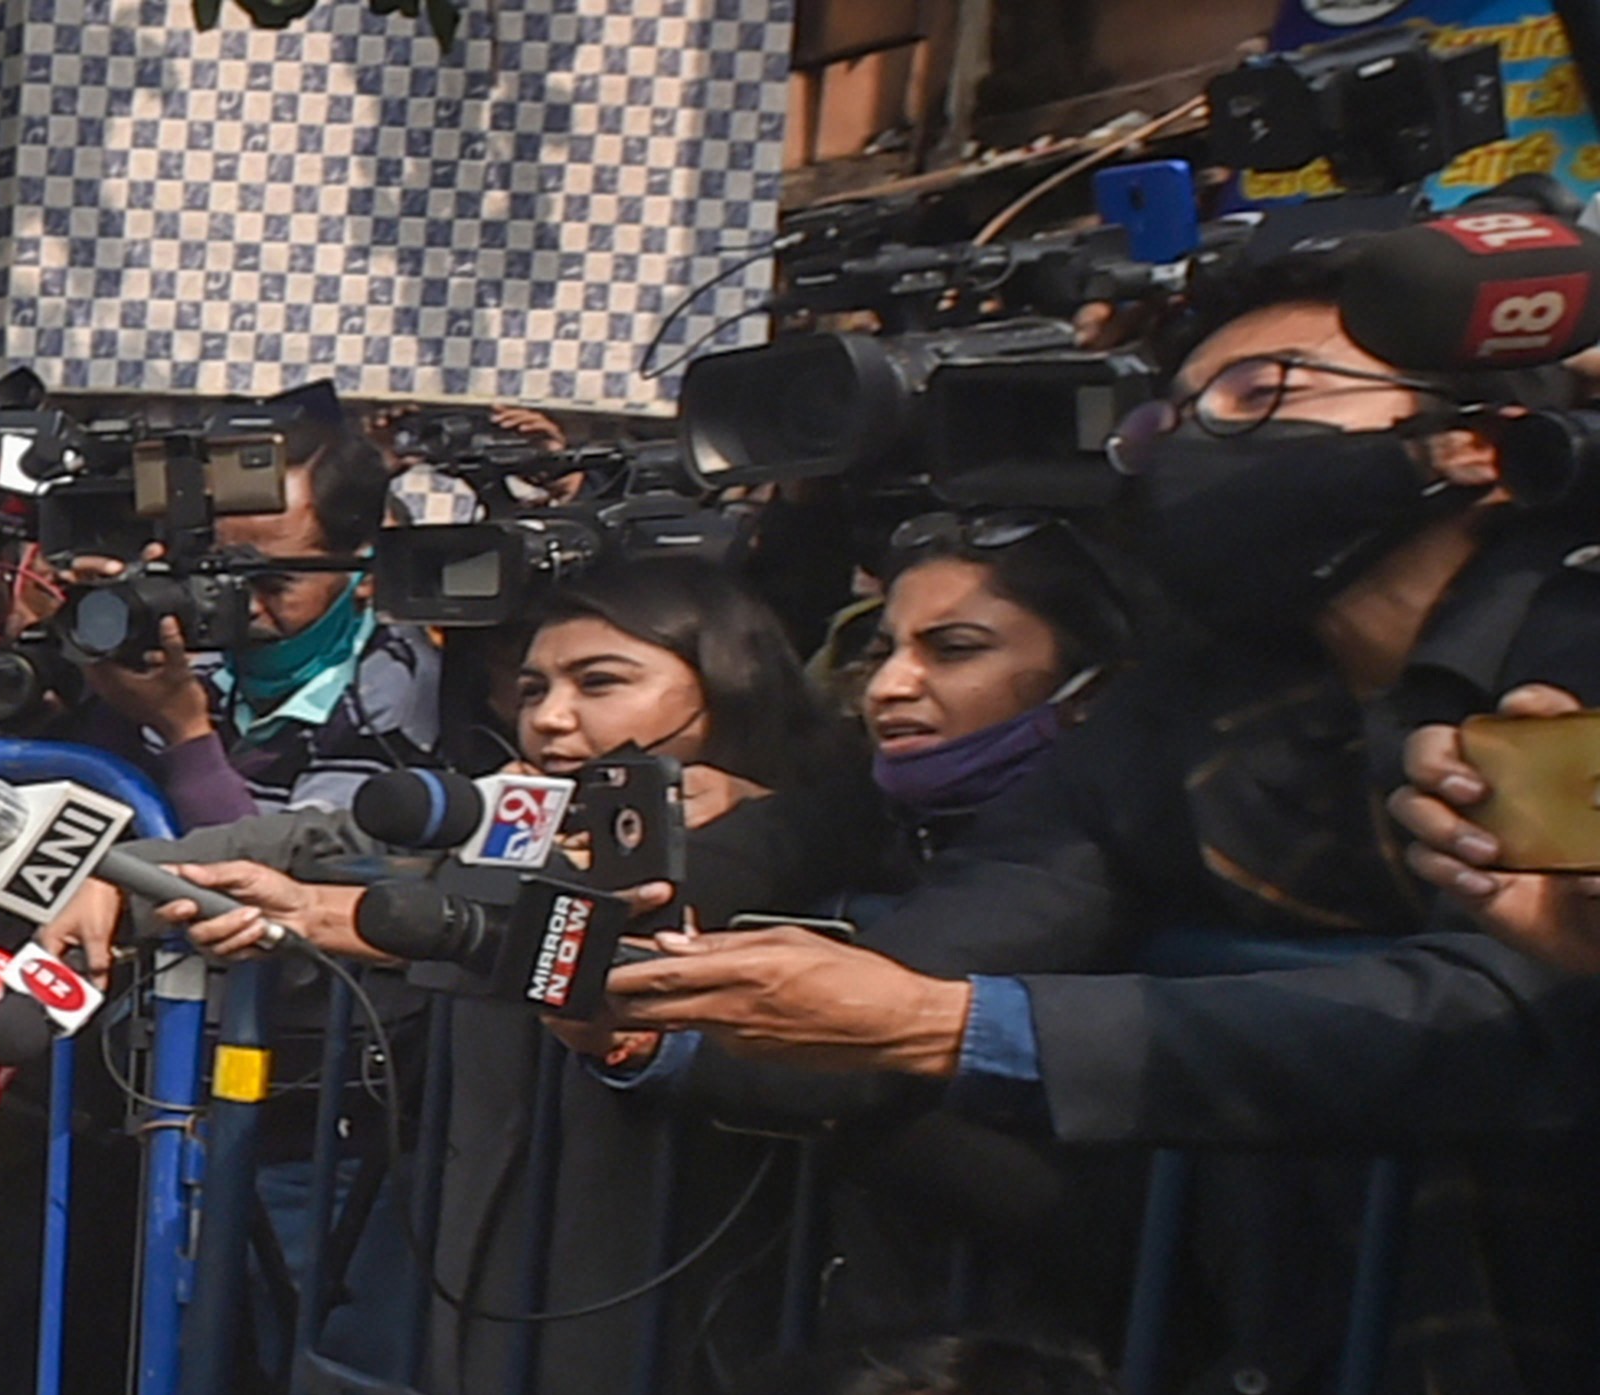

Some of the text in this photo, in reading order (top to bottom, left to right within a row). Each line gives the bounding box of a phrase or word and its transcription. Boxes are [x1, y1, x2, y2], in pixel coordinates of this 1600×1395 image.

[1454, 213, 1554, 248] 18
[1475, 290, 1566, 357] 18
[19, 806, 108, 903] ANI
[527, 895, 573, 1000] MIRROR
[546, 899, 592, 1000] NOW
